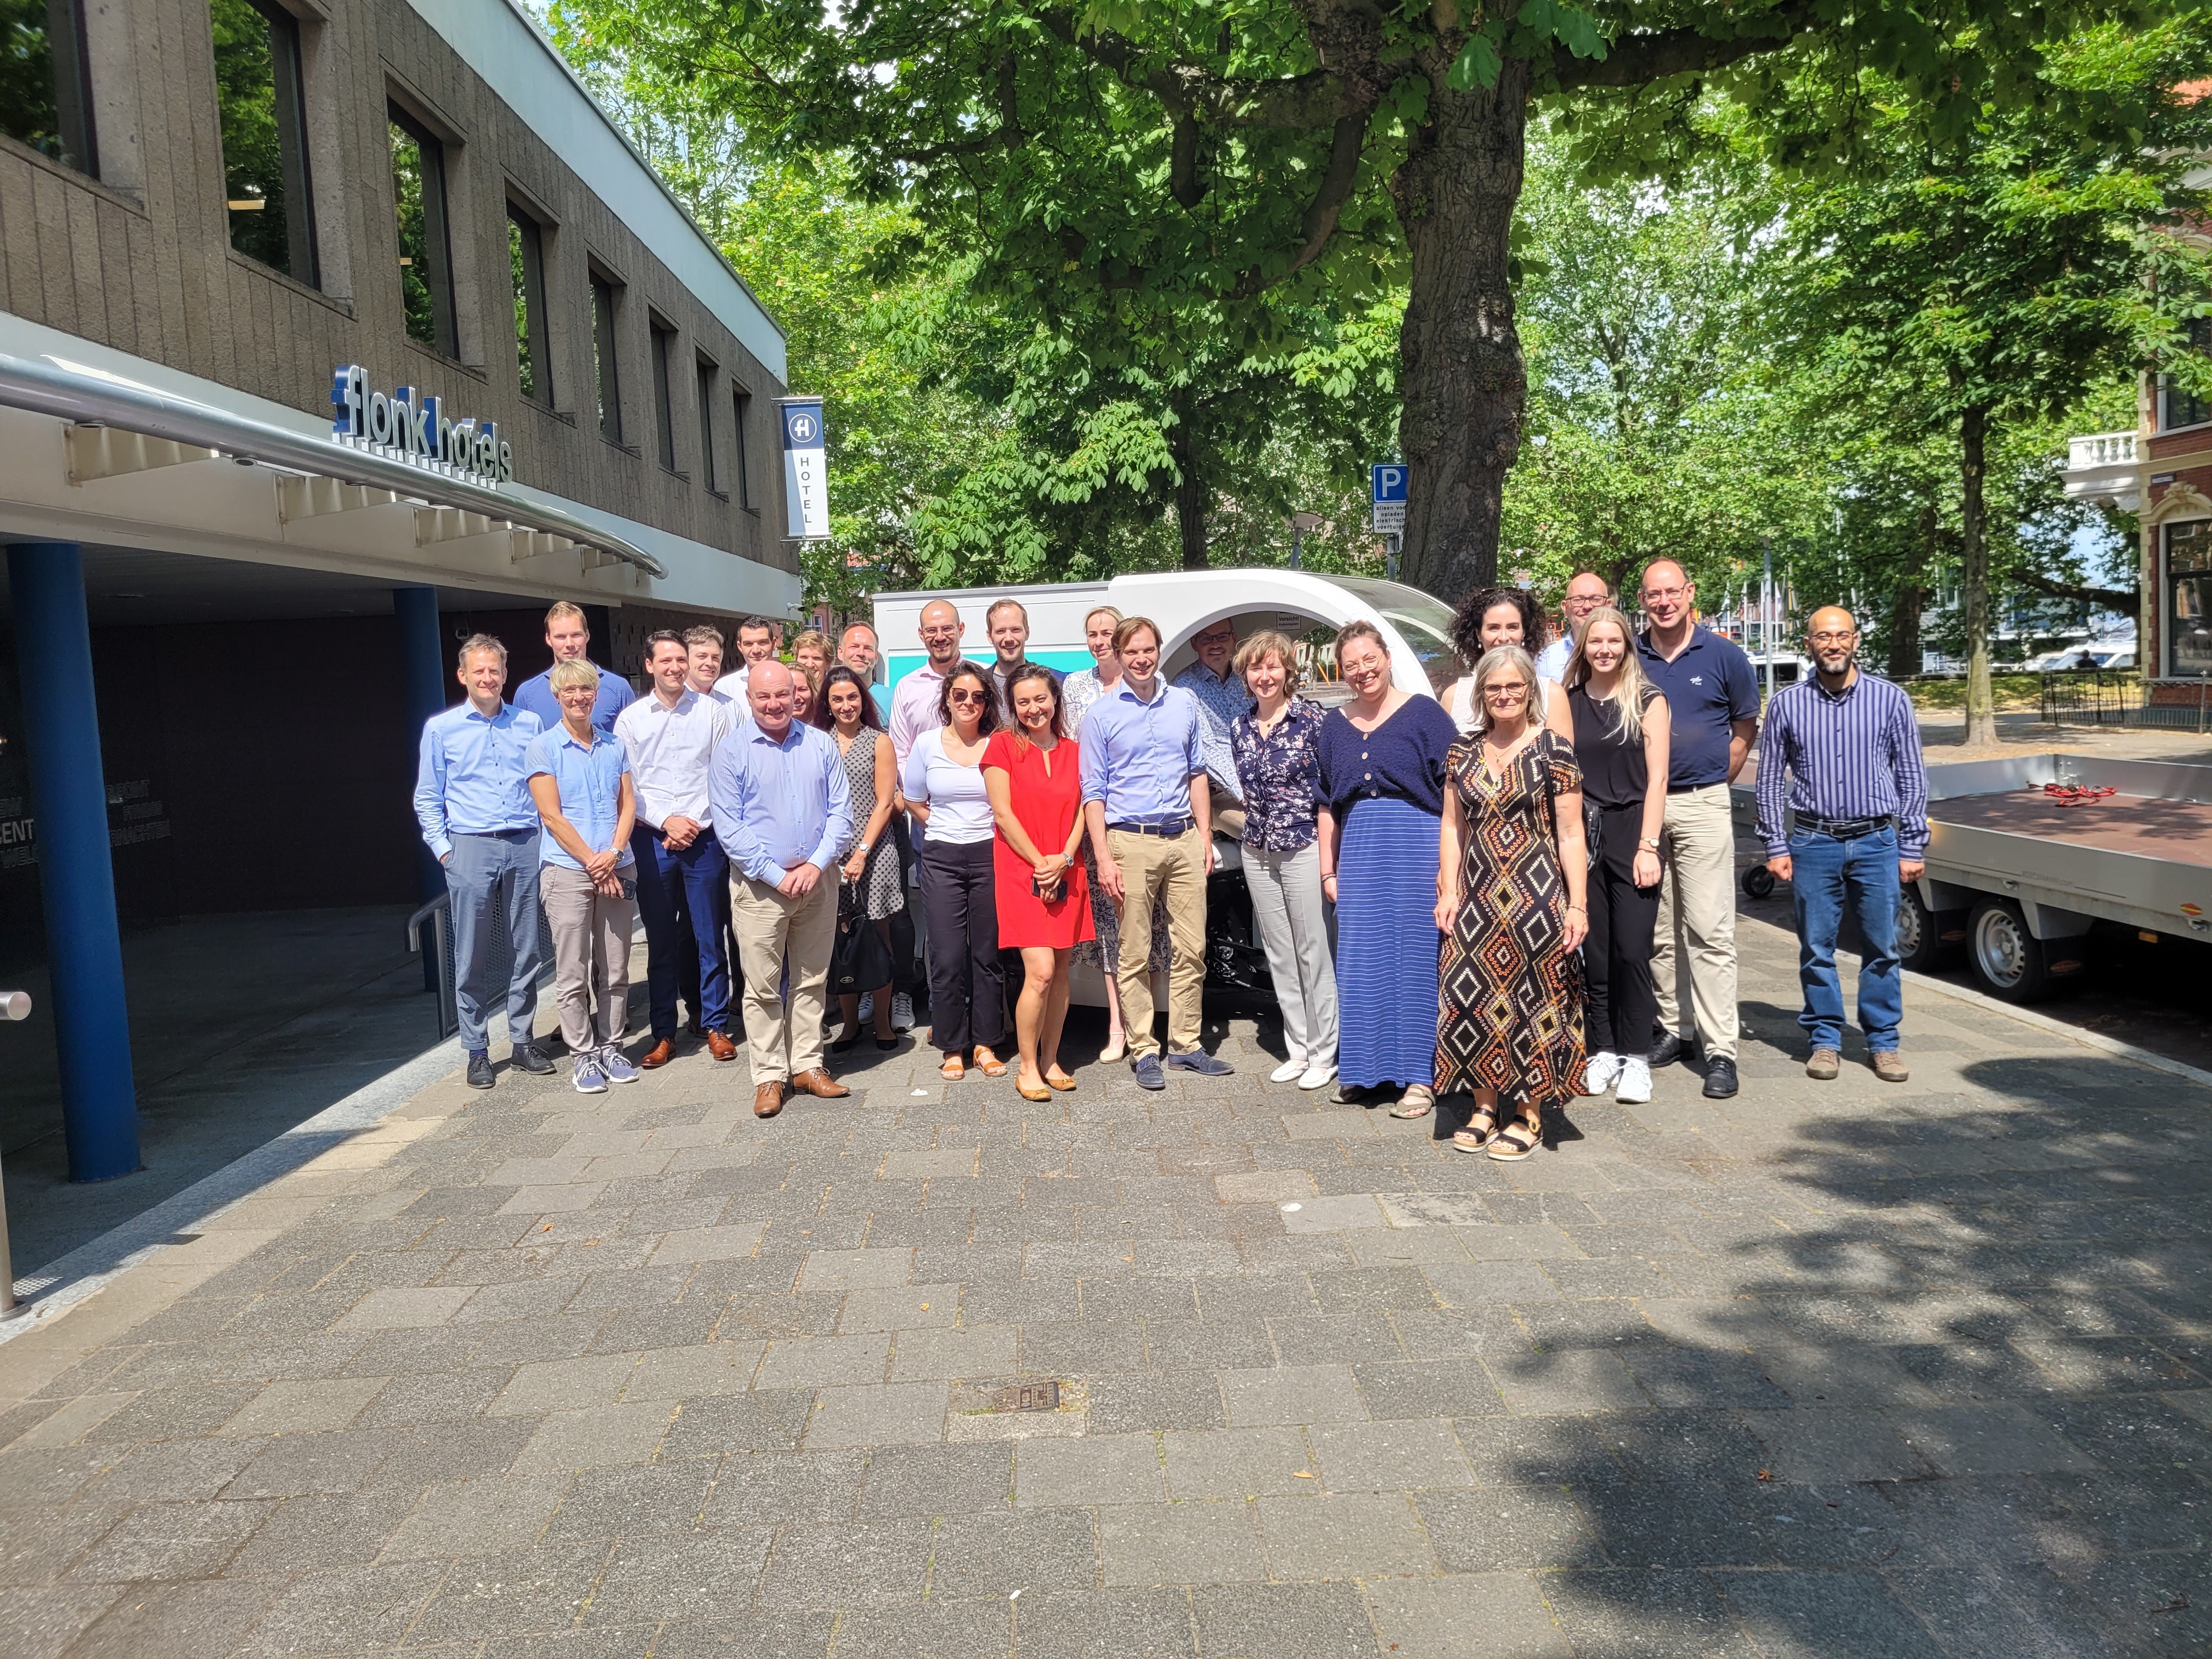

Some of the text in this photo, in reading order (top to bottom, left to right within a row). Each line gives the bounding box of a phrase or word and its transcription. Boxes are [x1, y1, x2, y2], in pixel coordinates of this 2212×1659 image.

[336, 365, 512, 483] flonk hotels
[800, 457, 812, 523] HOTEL
[1381, 469, 1401, 497] P
[0, 819, 34, 844] ENT
